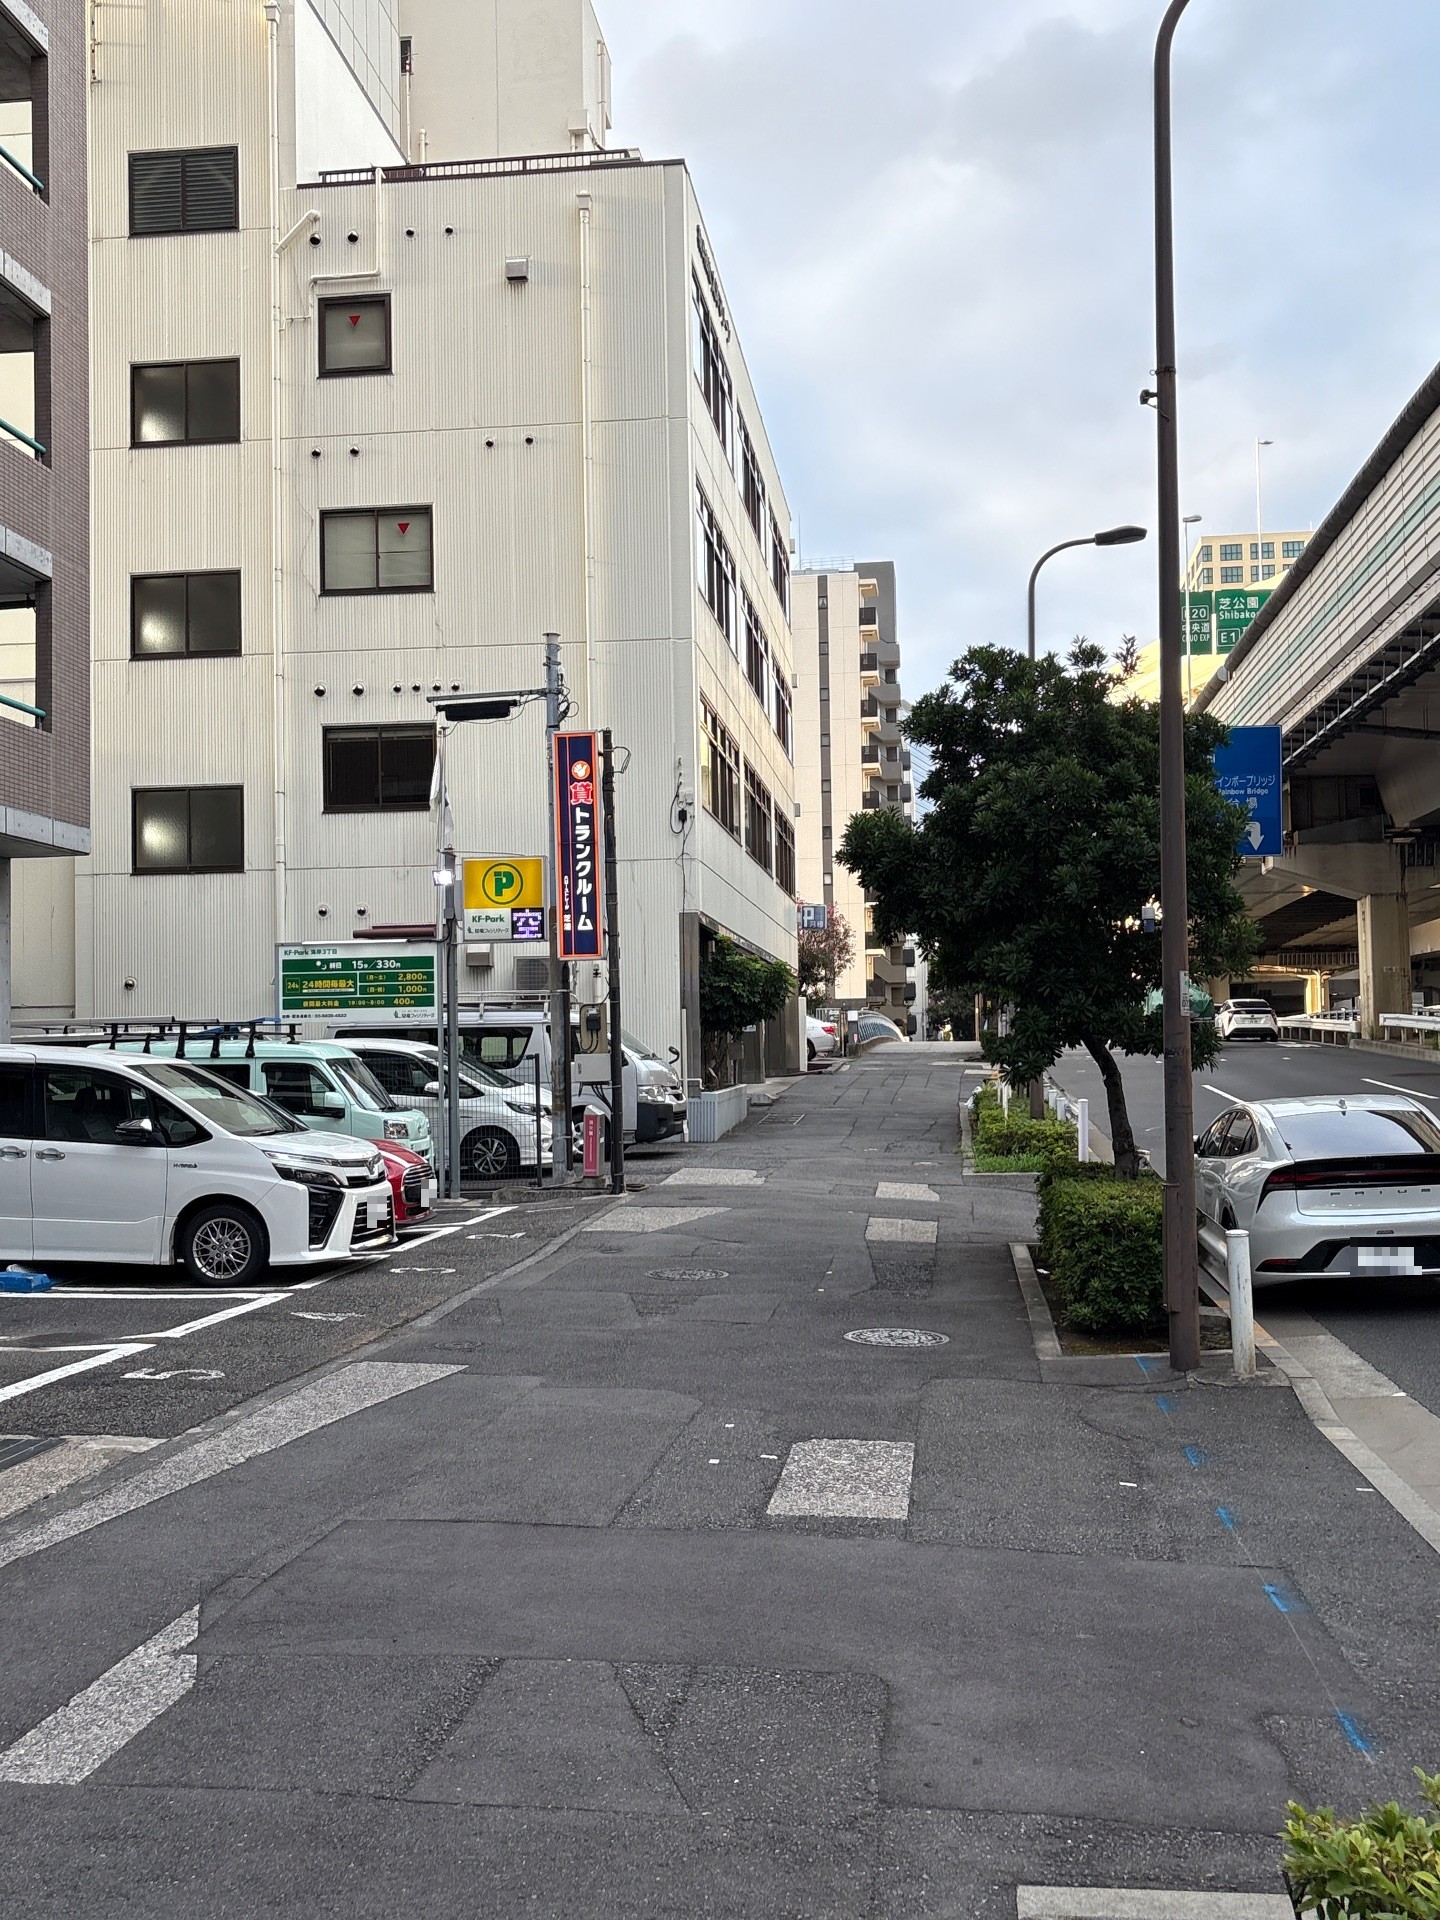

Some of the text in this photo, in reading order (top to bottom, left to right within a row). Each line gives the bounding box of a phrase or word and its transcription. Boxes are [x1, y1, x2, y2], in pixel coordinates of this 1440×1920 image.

[1218, 597, 1259, 610] 芝公園
[1220, 632, 1236, 643] E1
[1246, 788, 1269, 796] Bridge
[472, 914, 505, 923] KF-Park
[803, 907, 815, 927] P
[284, 948, 309, 956] KF-Park
[1330, 1188, 1431, 1196] PRIUS
